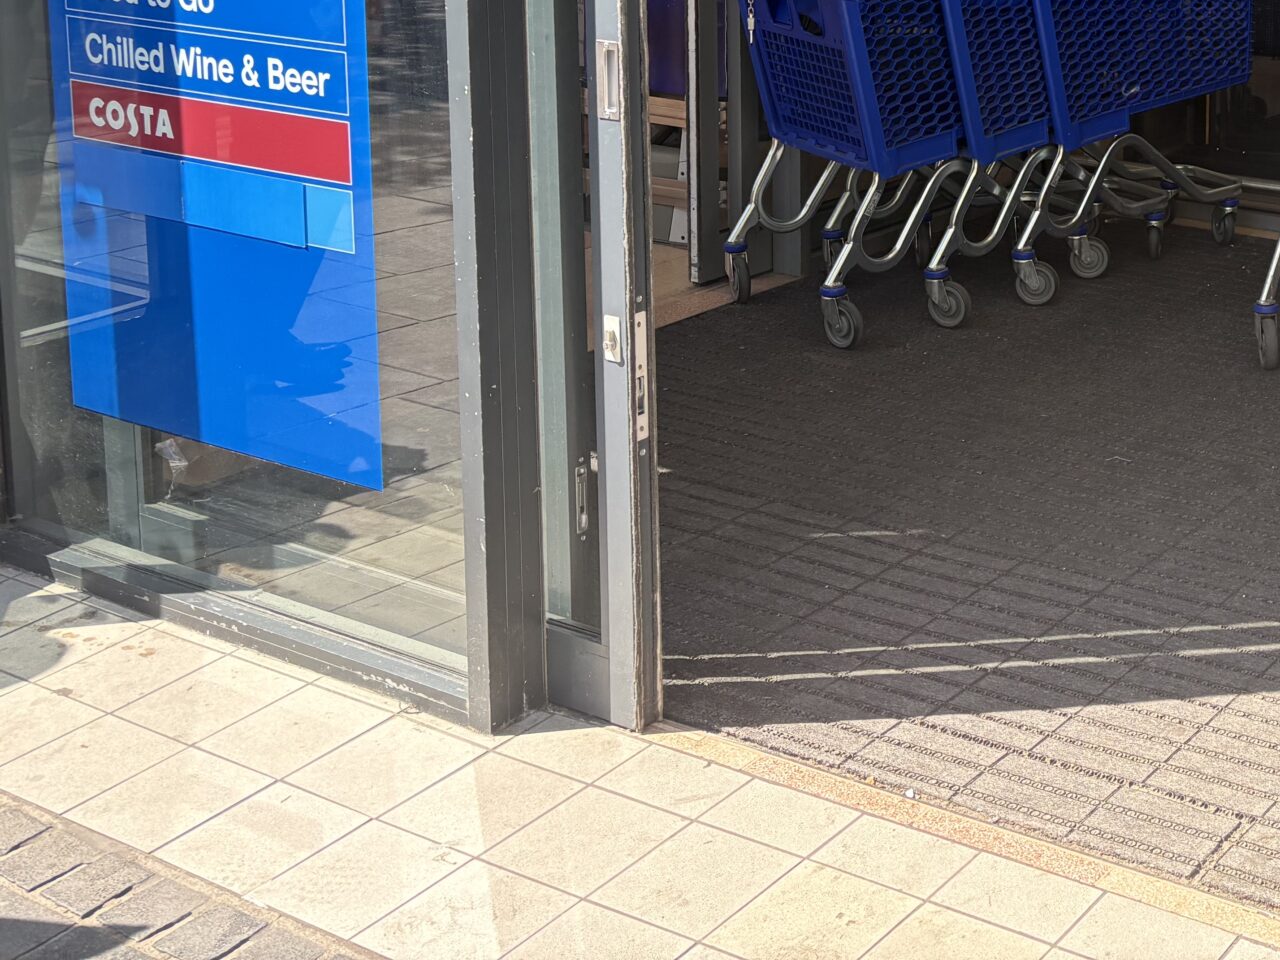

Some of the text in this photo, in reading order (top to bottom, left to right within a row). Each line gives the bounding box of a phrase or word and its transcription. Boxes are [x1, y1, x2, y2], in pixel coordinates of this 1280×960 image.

[84, 32, 331, 97] Chilled Wine & Beer
[88, 97, 175, 139] COSTA
